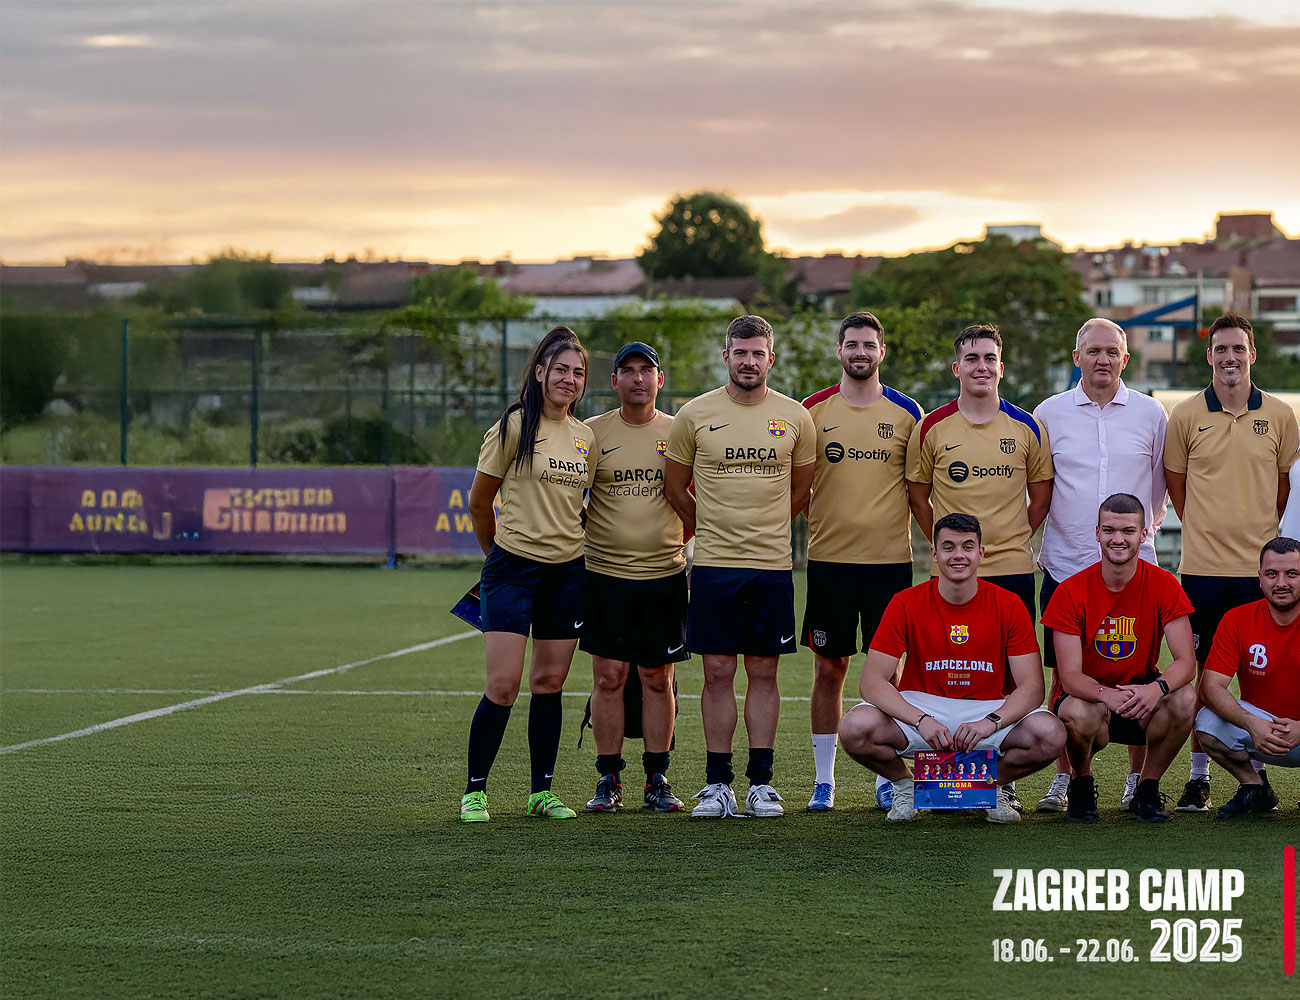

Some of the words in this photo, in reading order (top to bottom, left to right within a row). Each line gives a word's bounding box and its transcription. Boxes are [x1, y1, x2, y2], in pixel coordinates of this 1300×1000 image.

[725, 448, 777, 462] BARÇA
[848, 448, 891, 462] Spotify
[548, 457, 589, 476] BARÇA
[717, 462, 783, 476] Academy
[972, 465, 1015, 479] Spotify
[613, 469, 664, 483] BARÇA
[925, 659, 994, 673] BARCELONA
